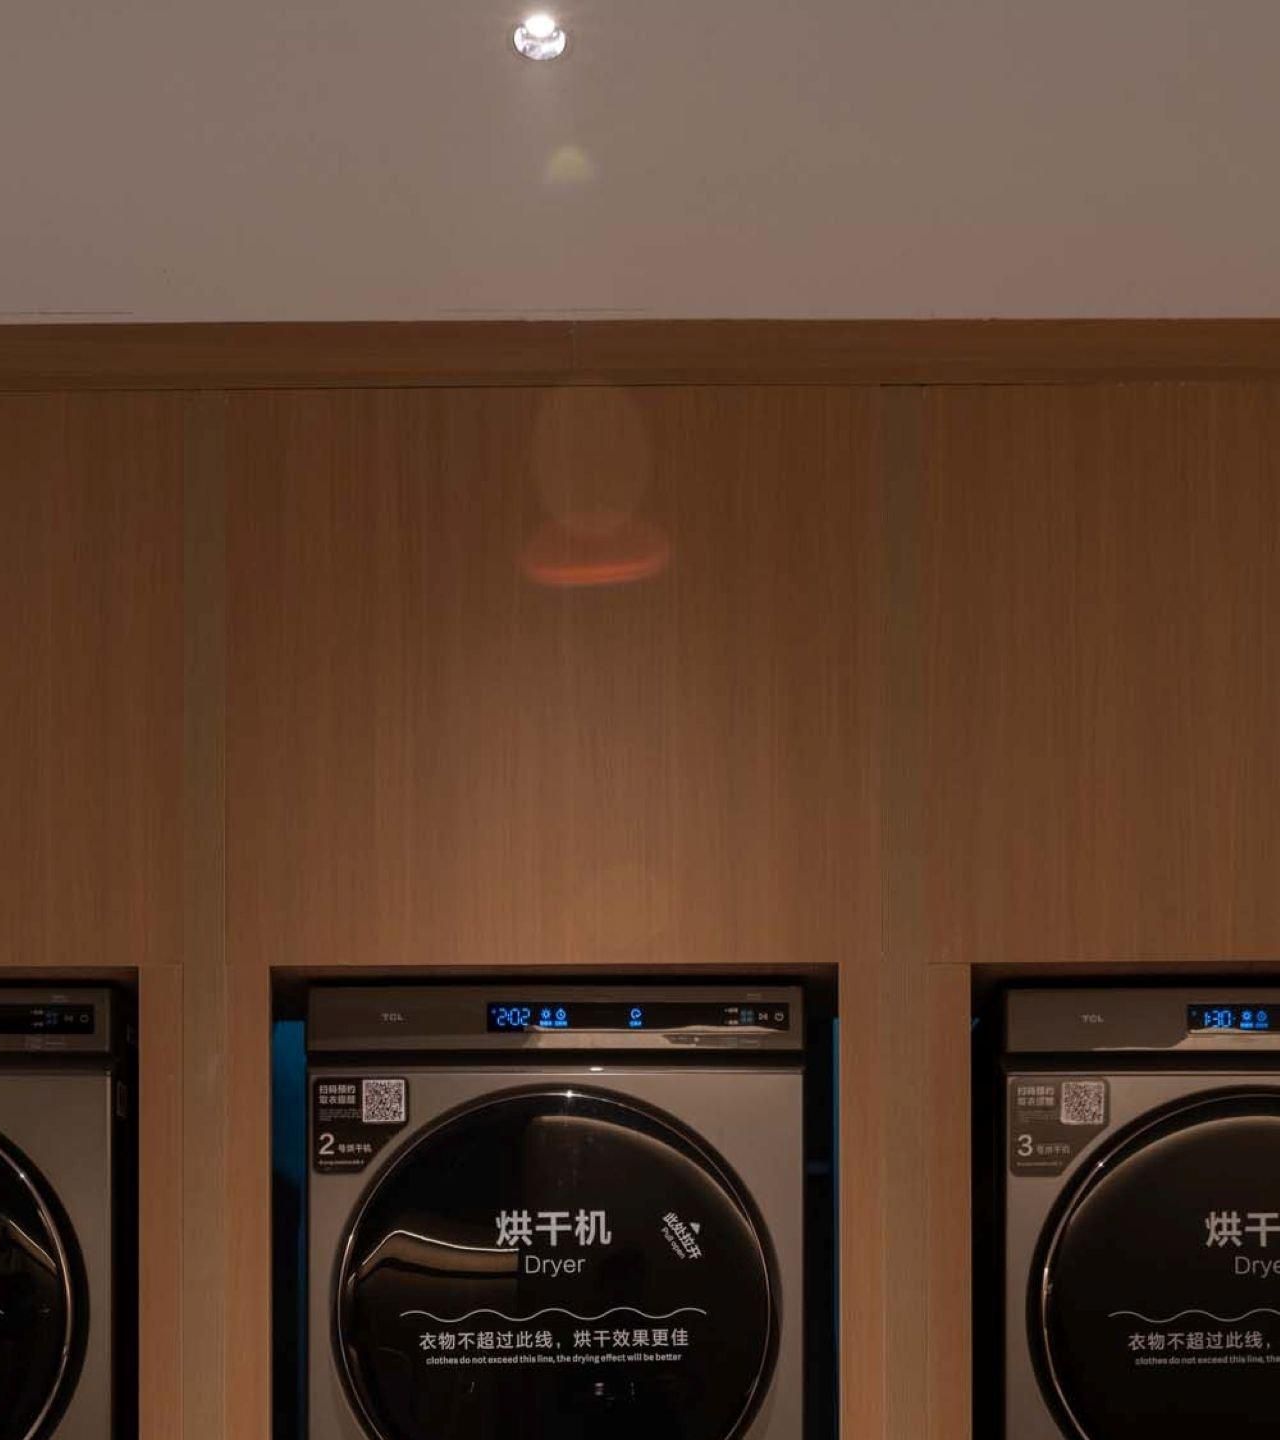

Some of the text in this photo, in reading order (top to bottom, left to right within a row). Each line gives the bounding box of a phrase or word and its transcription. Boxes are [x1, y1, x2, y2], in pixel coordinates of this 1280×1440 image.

[382, 1012, 404, 1022] TCL
[497, 1007, 530, 1026] 2:02
[1082, 1014, 1104, 1023] TCL
[318, 1133, 335, 1155] 2
[1017, 1134, 1033, 1156] 3
[495, 1209, 612, 1248] 烘干机
[524, 1254, 586, 1278] Dryer
[419, 1329, 688, 1349] 衣物不超过此线，烘干效果更佳
